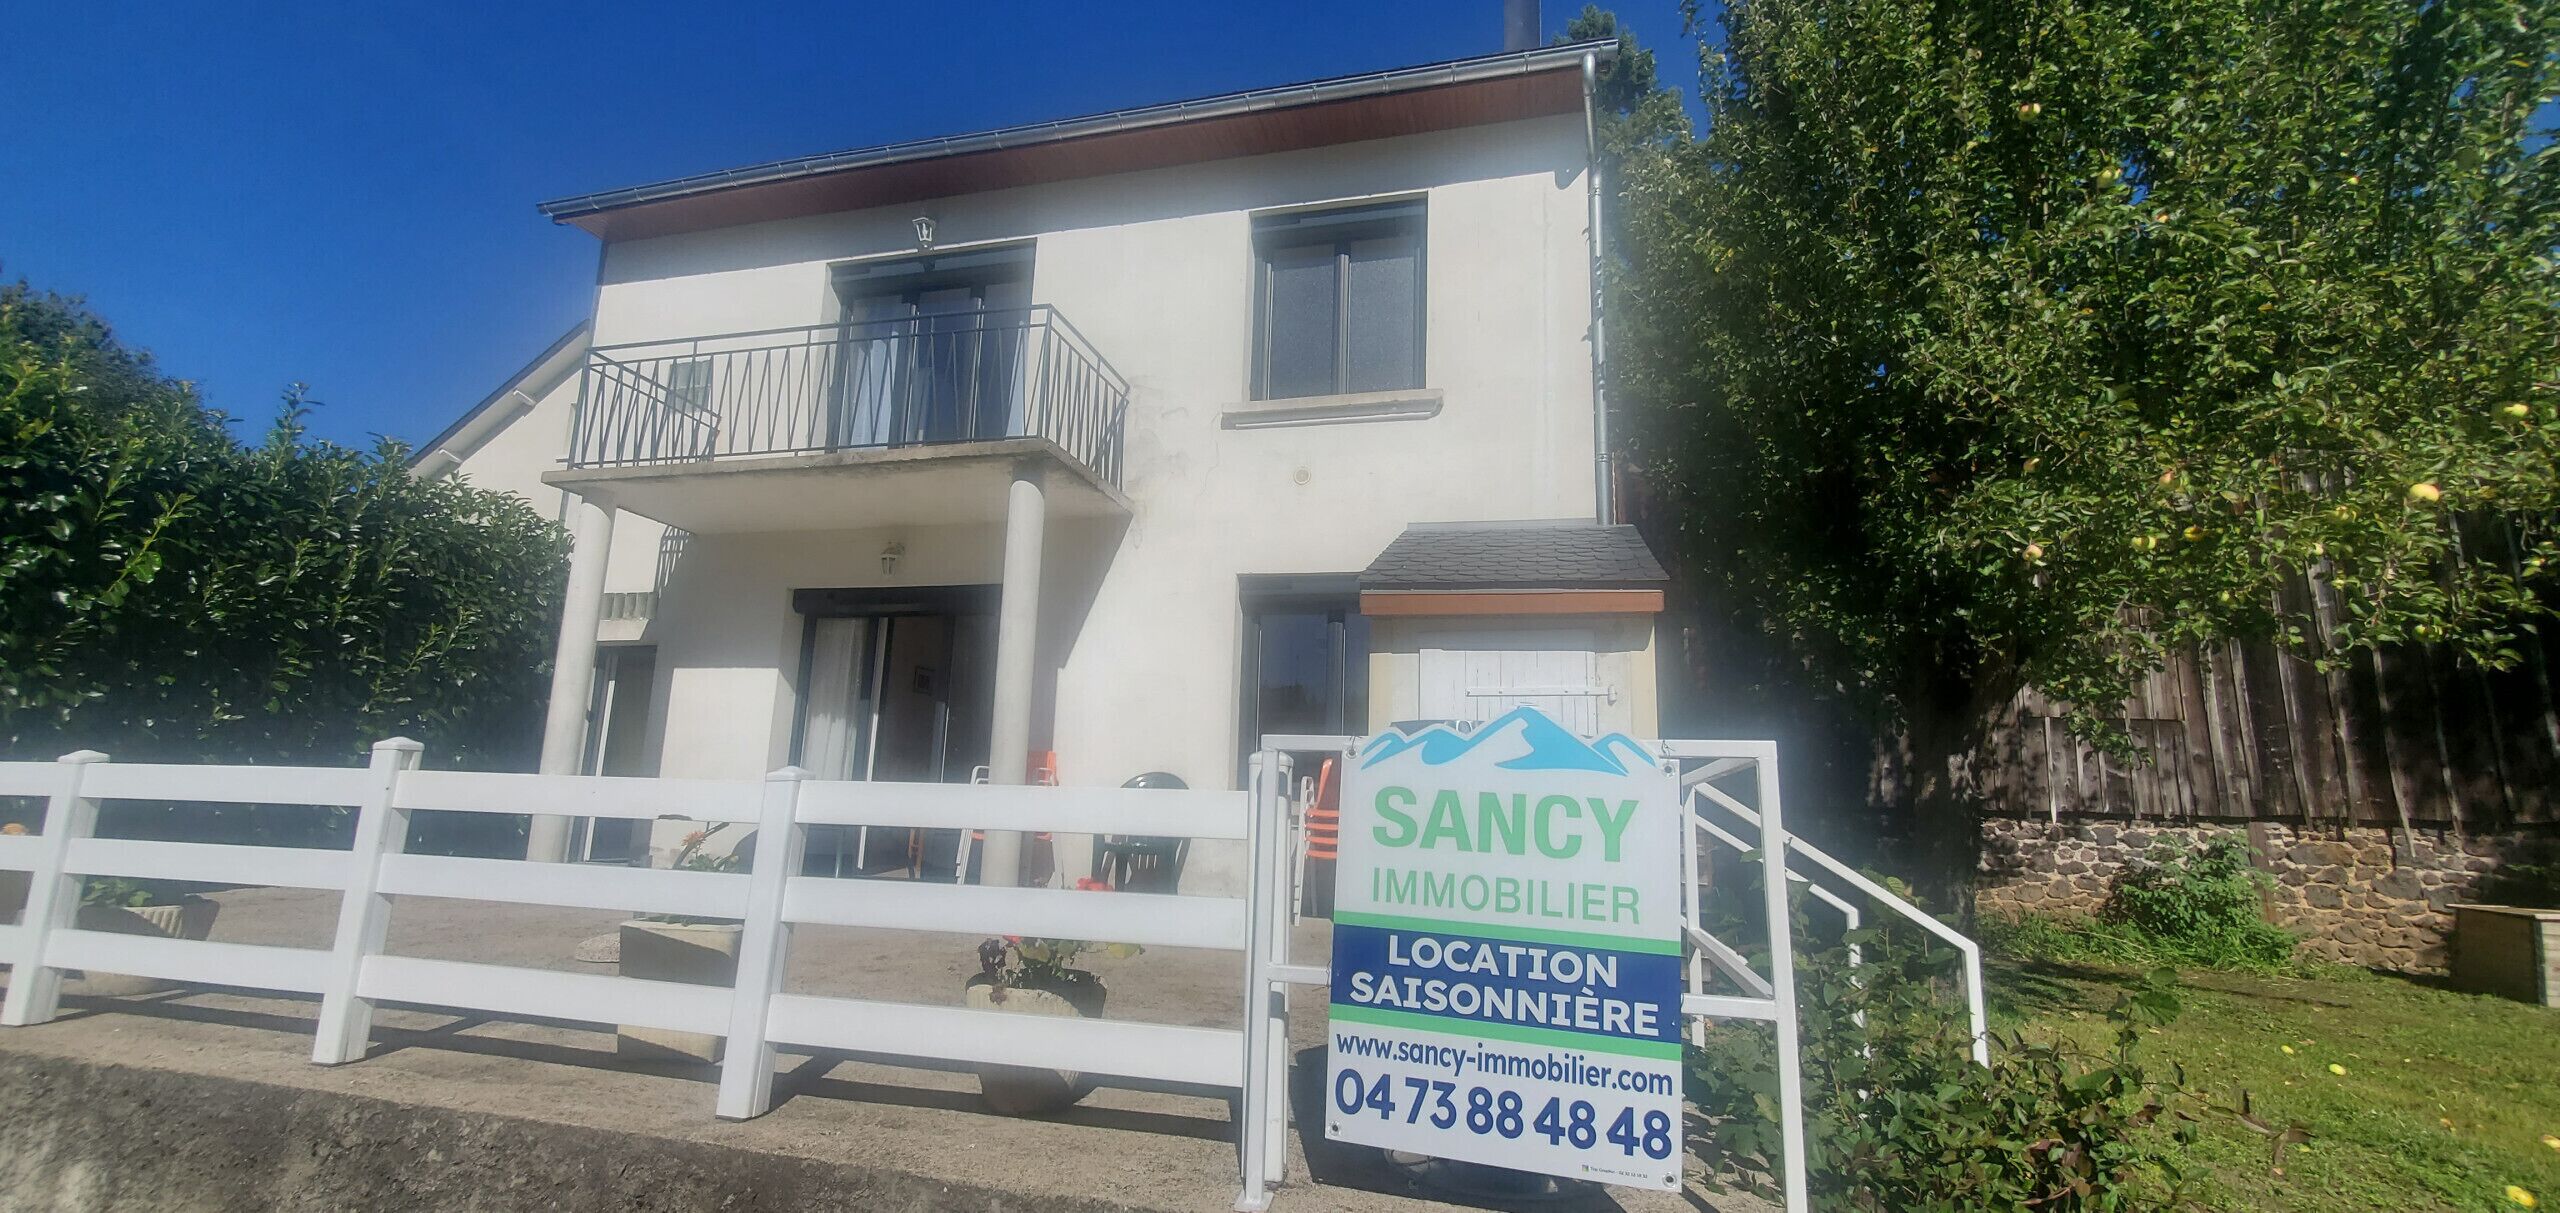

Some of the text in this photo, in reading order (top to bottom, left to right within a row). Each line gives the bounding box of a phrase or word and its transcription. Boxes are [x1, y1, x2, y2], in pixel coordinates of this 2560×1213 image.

[1372, 786, 1640, 863] SANCY
[1372, 867, 1640, 925] IMMOBILIER
[1388, 934, 1617, 988] LOCATION
[1350, 971, 1659, 1037] SAISONNIÈRE
[1336, 1033, 1673, 1096] www.sancy-immobilier.com
[1335, 1068, 1672, 1160] 04 73 88 48 48
